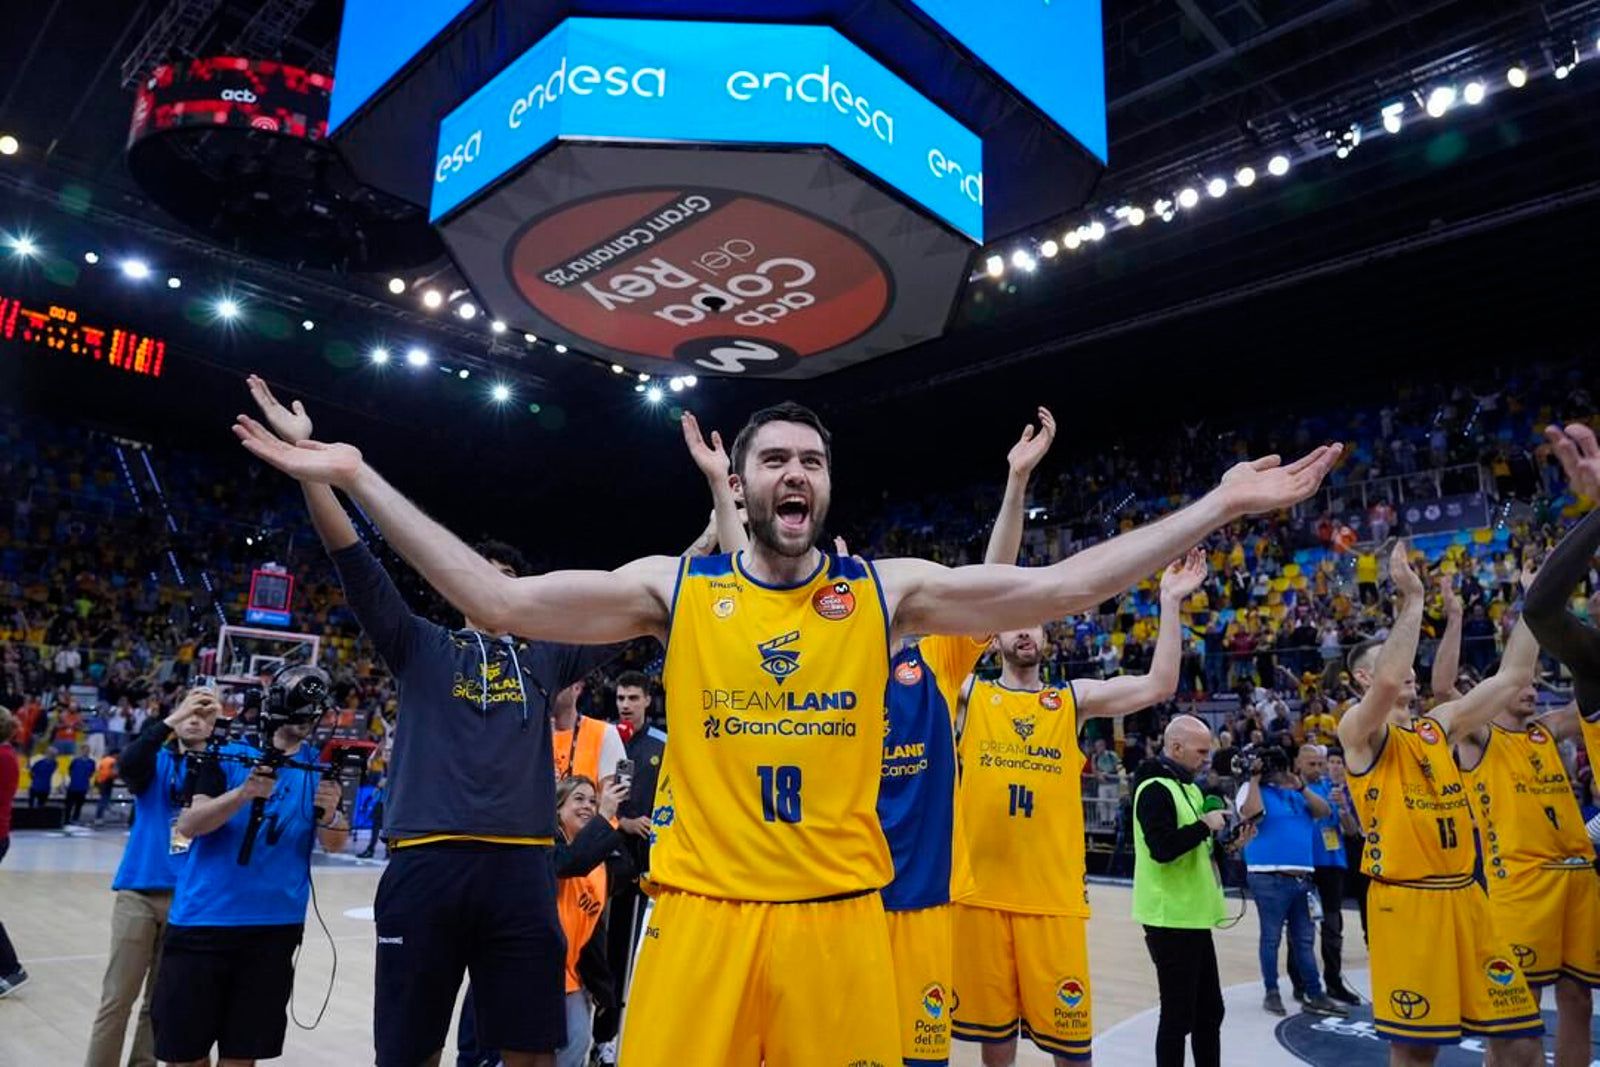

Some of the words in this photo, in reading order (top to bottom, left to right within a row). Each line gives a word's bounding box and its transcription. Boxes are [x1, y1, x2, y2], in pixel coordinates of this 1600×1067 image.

[221, 87, 257, 103] acb
[508, 57, 667, 129] endesa
[726, 65, 894, 144] endesa
[435, 129, 482, 183] esa
[647, 195, 711, 236] Gran
[572, 227, 653, 274] Canaria
[692, 238, 756, 276] del
[580, 257, 698, 312] Rey
[653, 257, 817, 328] Copa
[734, 290, 816, 328] acb
[703, 689, 857, 712] DREAMLAND
[724, 716, 857, 738] GranCanaria
[979, 740, 1062, 760] DREAMLAND
[995, 756, 1062, 775] GranCanaria
[756, 765, 803, 824] 18
[1008, 783, 1034, 818] 14
[1435, 817, 1458, 849] 15
[914, 1033, 931, 1046] del
